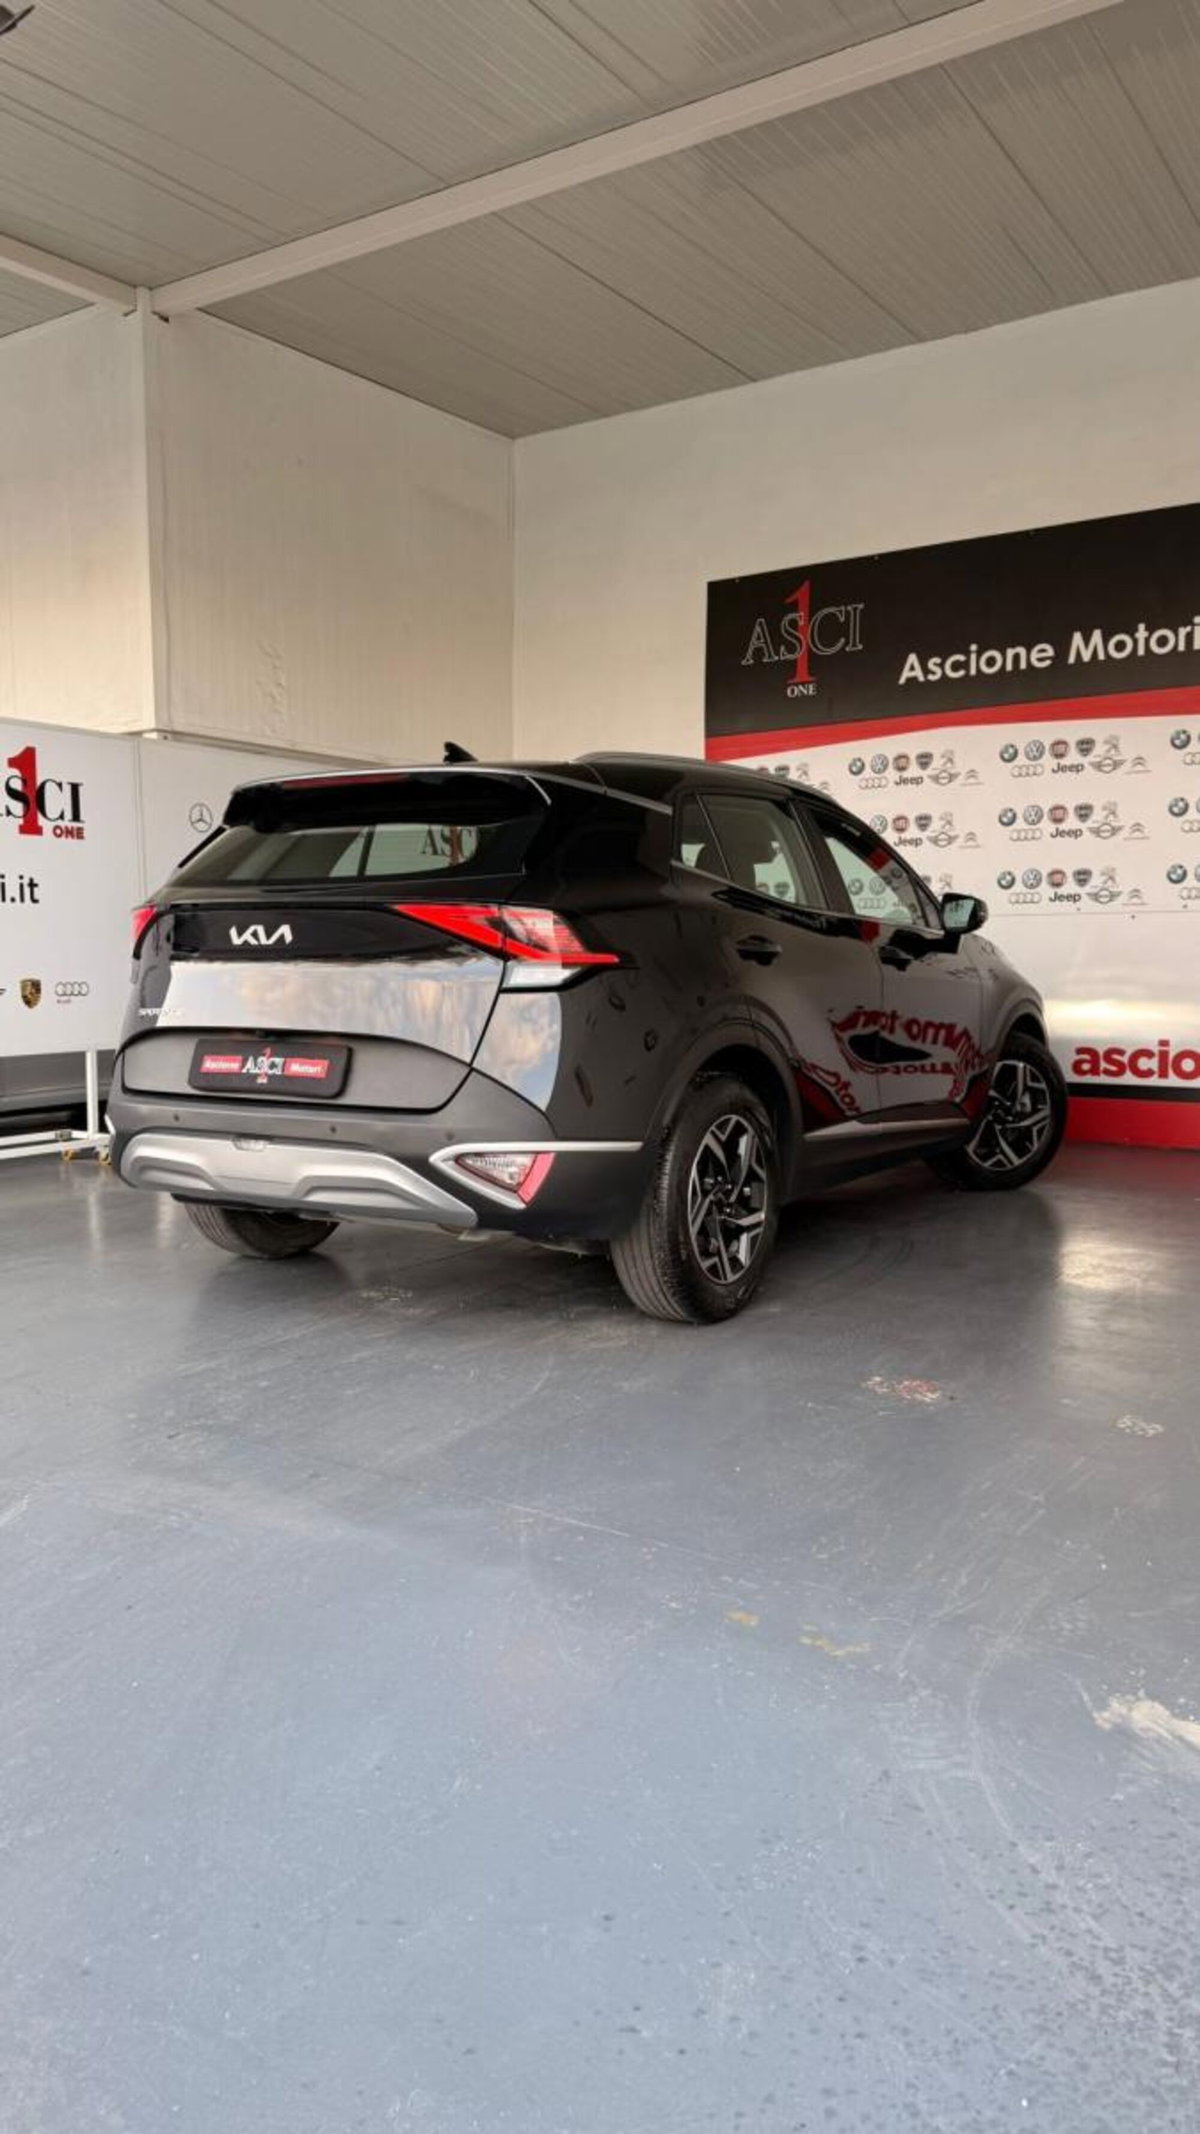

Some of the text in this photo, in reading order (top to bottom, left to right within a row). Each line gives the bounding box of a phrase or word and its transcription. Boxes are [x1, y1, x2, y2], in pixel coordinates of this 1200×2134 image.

[740, 603, 865, 665] ASCI
[898, 615, 1200, 685] Ascione Motori
[786, 684, 817, 698] ONE
[1051, 762, 1085, 775] Jeep
[894, 775, 924, 788] Jeep
[52, 824, 86, 841] ONE
[1050, 827, 1083, 840] Jeep
[893, 836, 923, 848] Jeep
[1048, 891, 1082, 904] Jeep
[229, 924, 293, 946] KIA
